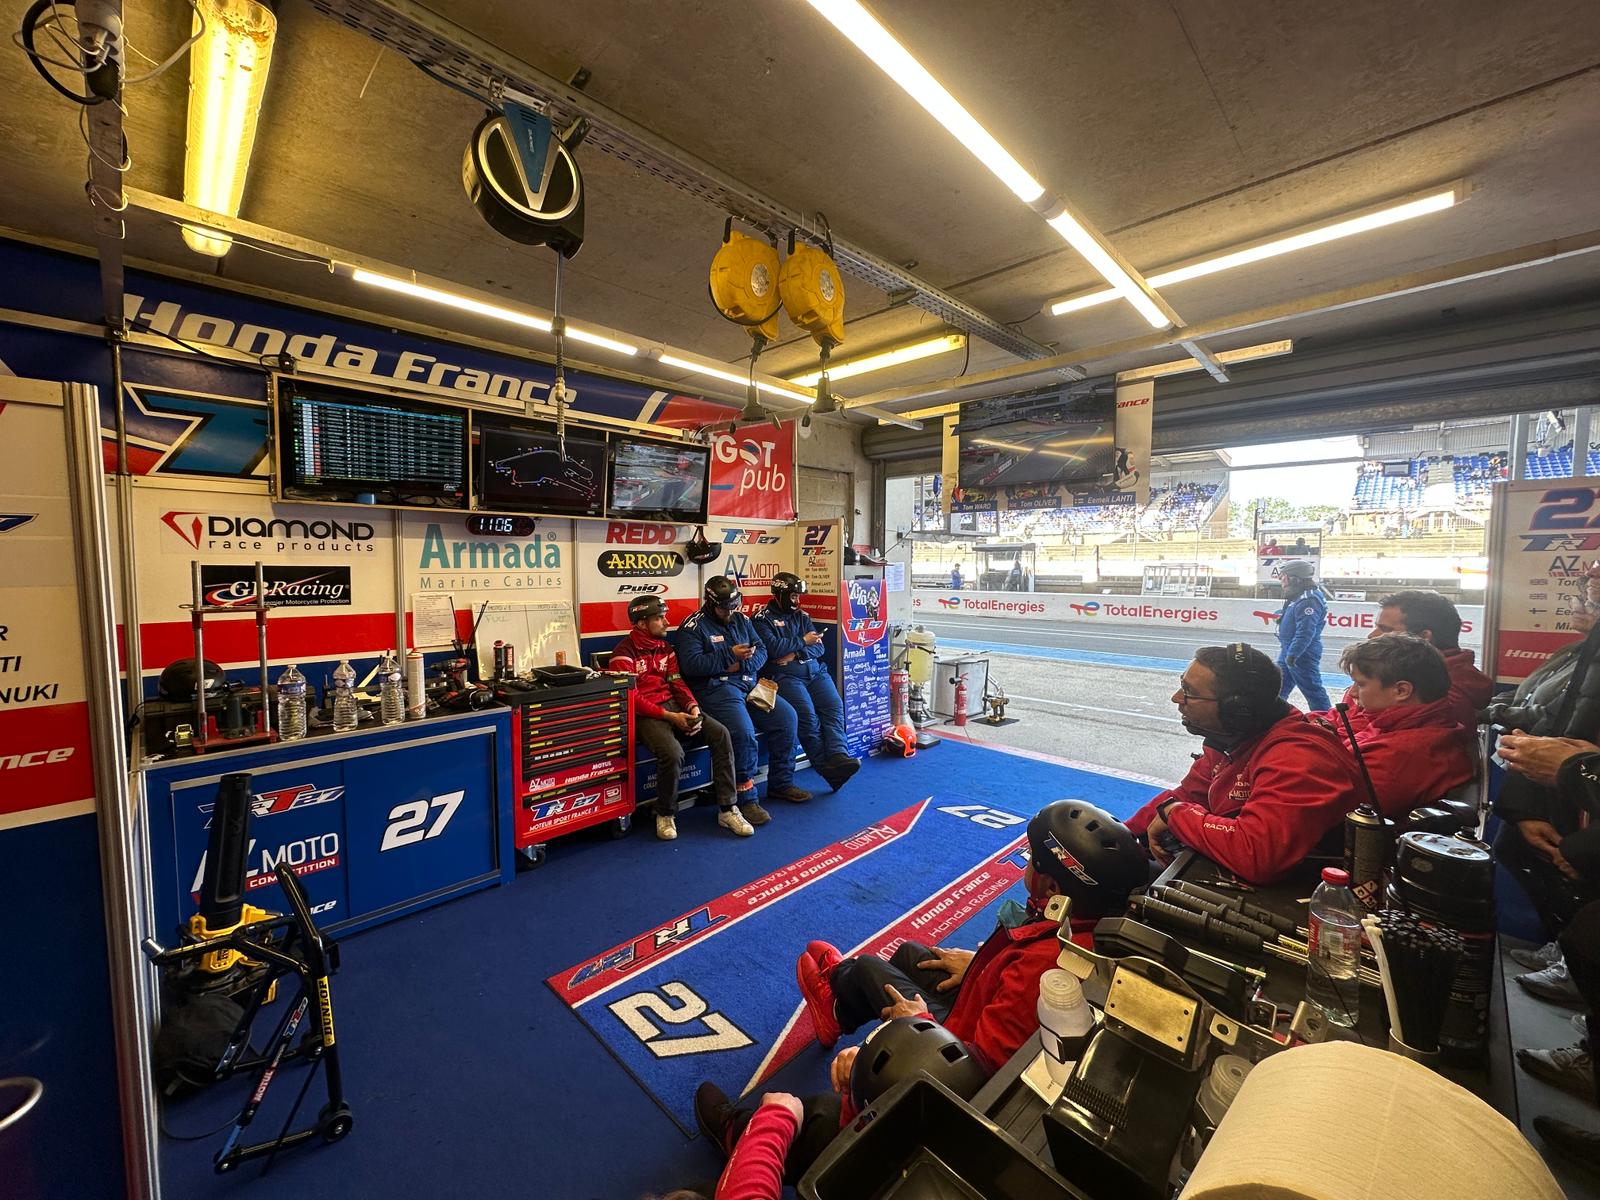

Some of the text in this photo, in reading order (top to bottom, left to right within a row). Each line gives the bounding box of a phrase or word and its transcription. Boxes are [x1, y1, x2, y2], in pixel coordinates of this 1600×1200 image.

[123, 294, 579, 408] Honda France
[739, 465, 785, 496] pub
[974, 502, 992, 510] WARD
[1020, 498, 1057, 508] Tom OLIVER
[1111, 494, 1133, 504] LAHTI
[208, 538, 374, 553] race products
[419, 523, 561, 569] Armada
[804, 525, 832, 546] 27
[606, 553, 678, 569] ARROW
[749, 563, 780, 580] MOTO
[421, 575, 561, 589] Marine Cables
[618, 584, 659, 593] Puig
[963, 598, 1045, 615] TotalEnergies
[1104, 603, 1218, 623] TotalEnergies
[564, 767, 615, 784] Honda France
[592, 760, 612, 770] MOTUL
[380, 790, 465, 852] 27
[529, 808, 592, 832] MOTEUR SPORT FRANCE
[936, 804, 1028, 829] 27
[262, 832, 339, 873] MOTO
[731, 869, 788, 898] RACING
[747, 853, 844, 905] Honda France
[910, 871, 991, 929] Honda France
[972, 878, 1009, 907] RACING
[318, 980, 334, 1036] DUNLOP
[606, 980, 757, 1060] 27
[254, 1069, 275, 1102] MOTUL
